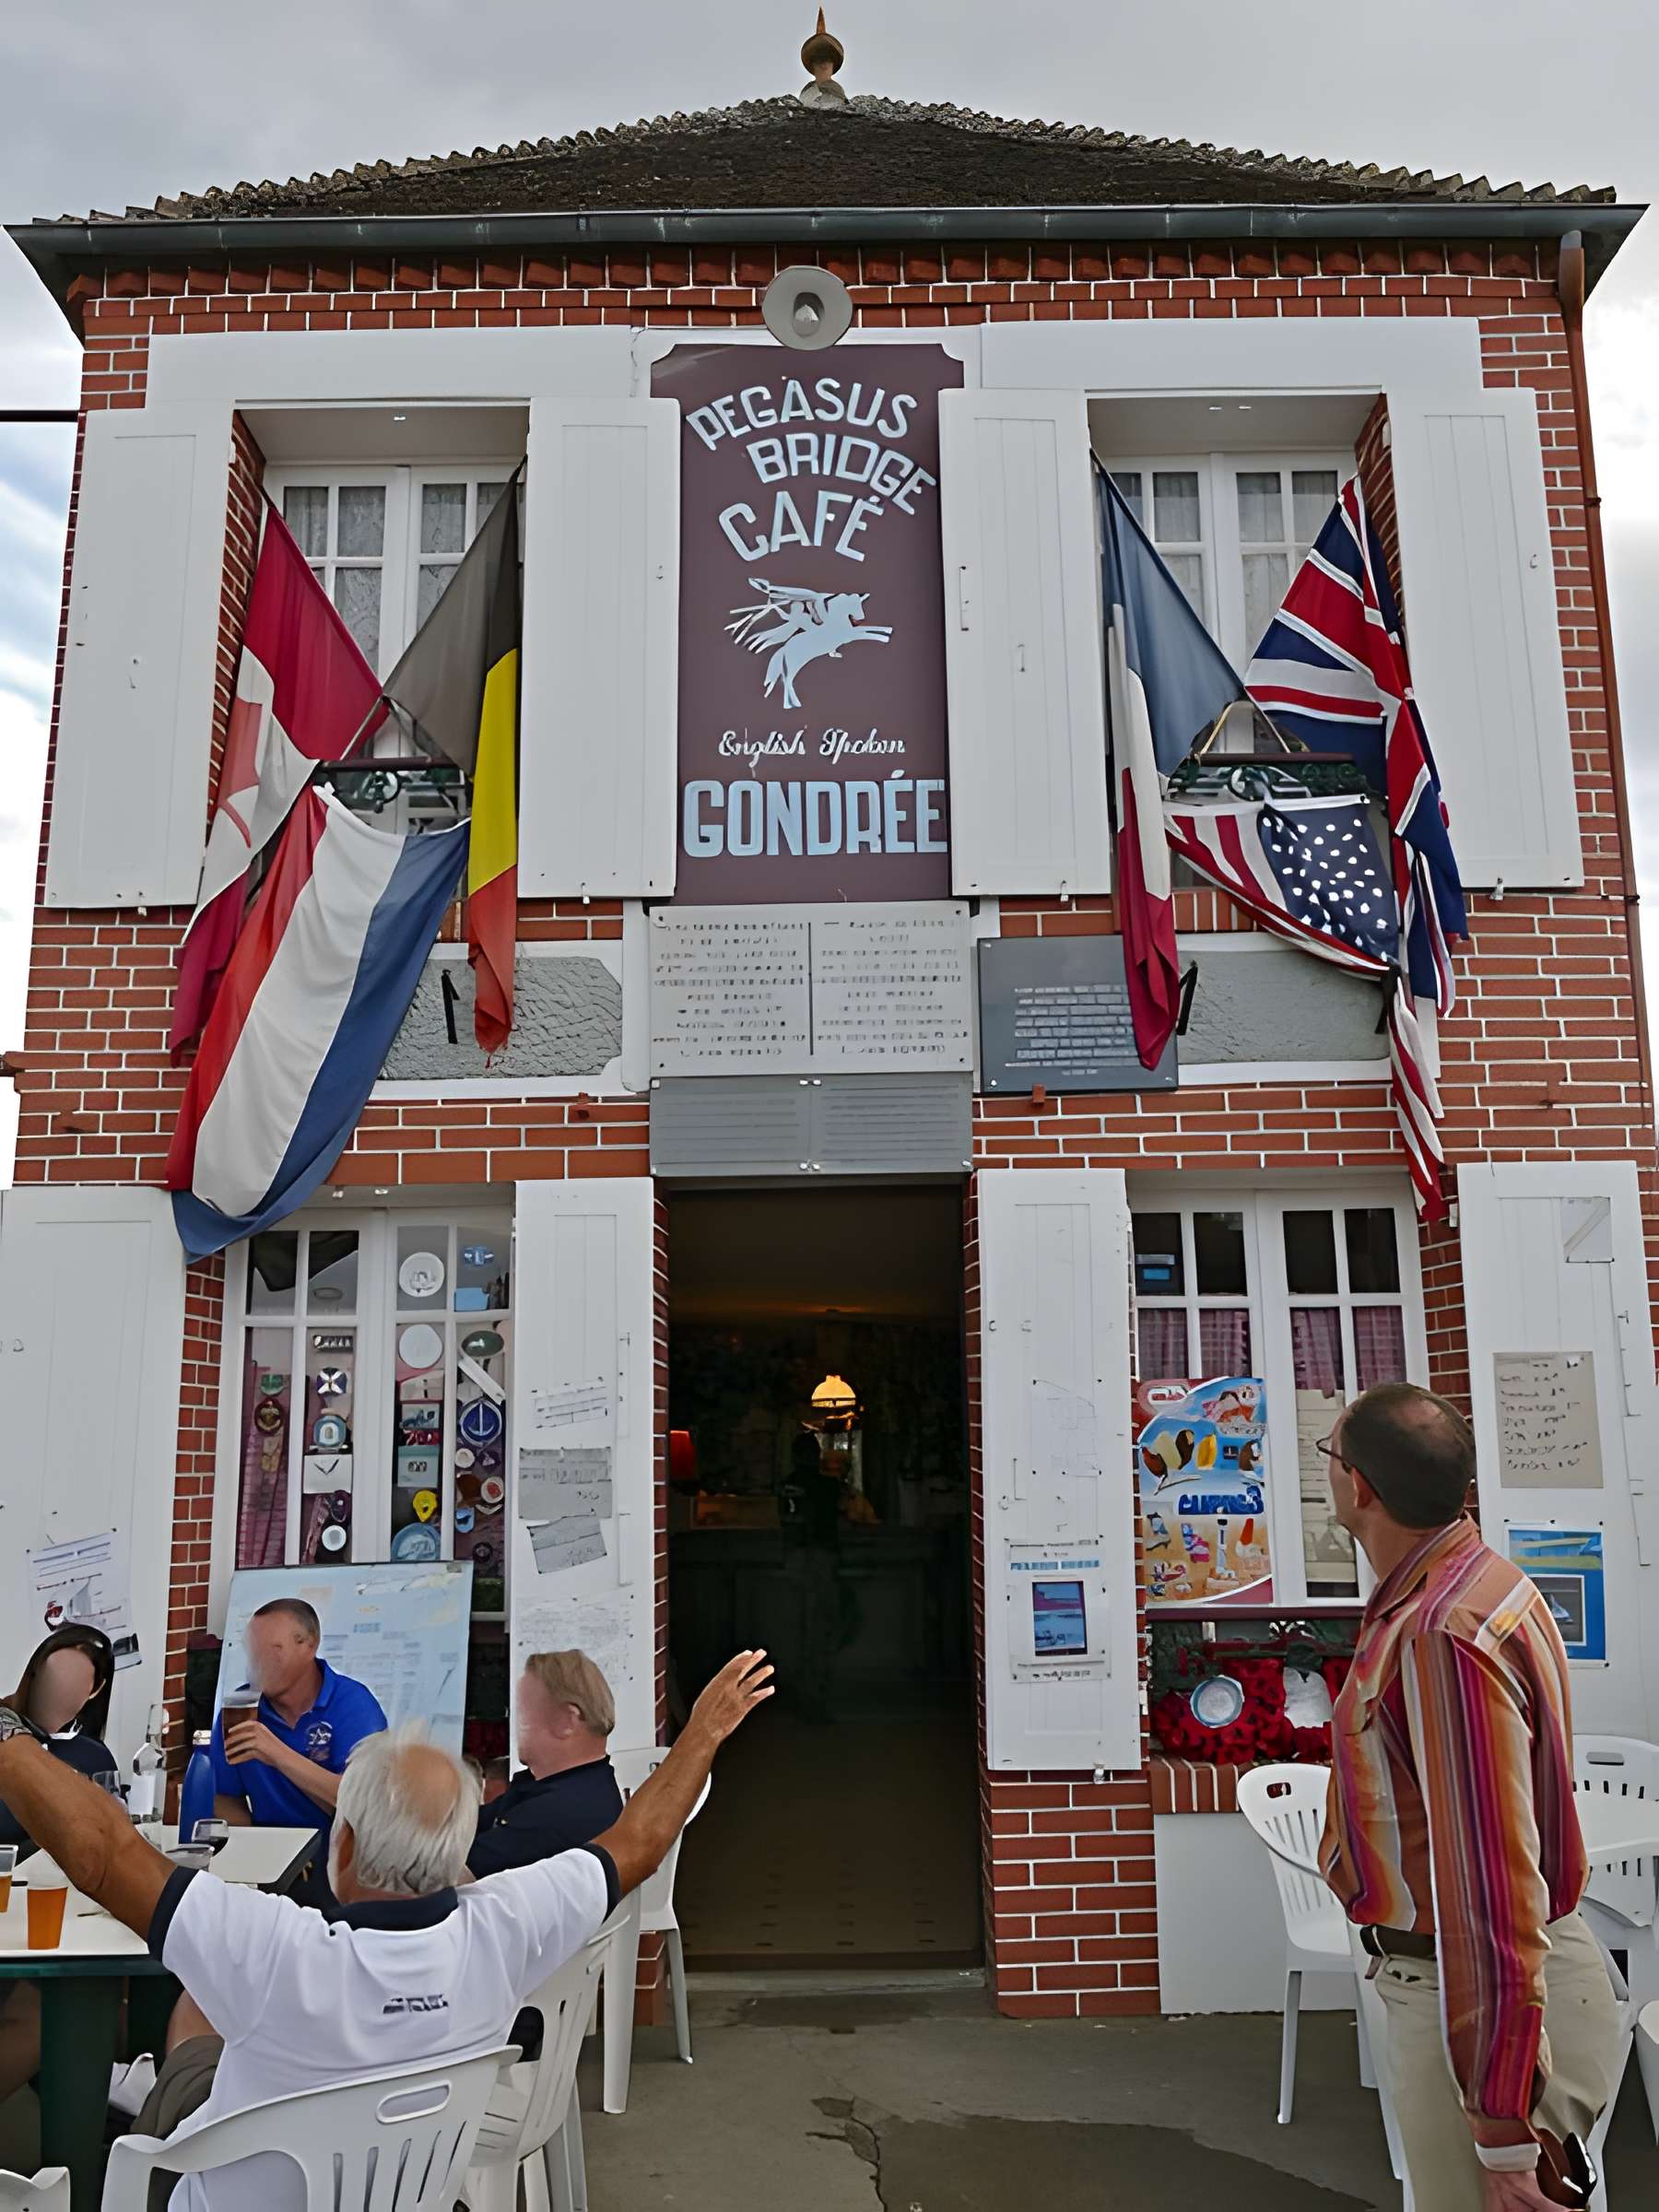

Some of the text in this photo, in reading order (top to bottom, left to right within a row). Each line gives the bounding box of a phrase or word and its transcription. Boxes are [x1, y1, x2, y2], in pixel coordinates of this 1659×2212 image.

[686, 378, 918, 451] PEGASUS
[746, 433, 936, 515] BRIDGE
[719, 490, 884, 562] CAFÉ
[718, 728, 806, 768] English
[684, 770, 948, 858] GONDRÉE
